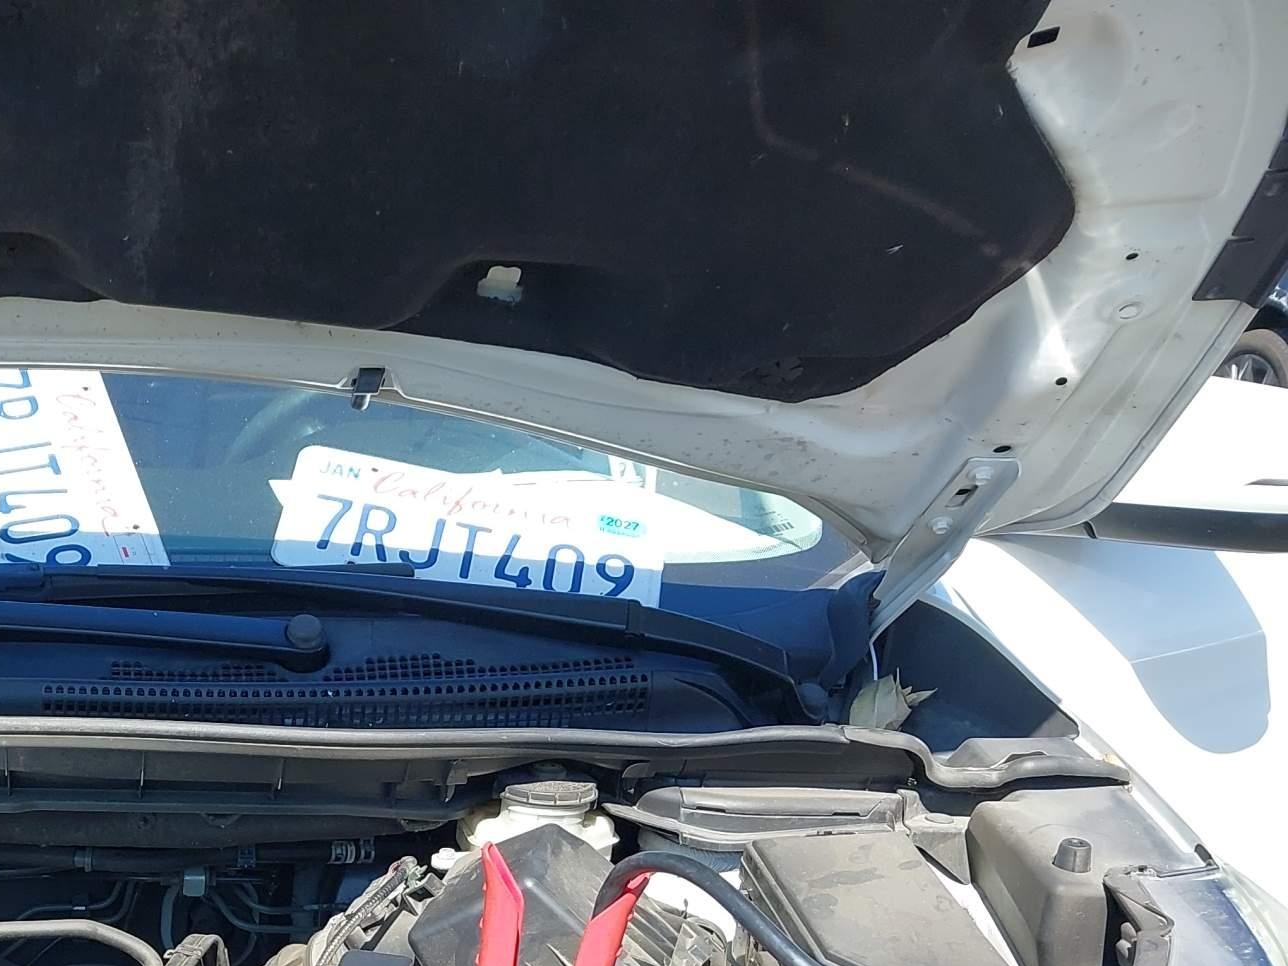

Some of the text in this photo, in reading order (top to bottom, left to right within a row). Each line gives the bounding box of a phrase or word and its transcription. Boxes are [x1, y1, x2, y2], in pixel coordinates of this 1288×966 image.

[319, 460, 362, 481] JAN
[363, 472, 572, 530] California
[606, 516, 640, 532] 2027
[315, 494, 636, 597] 7RJT409
